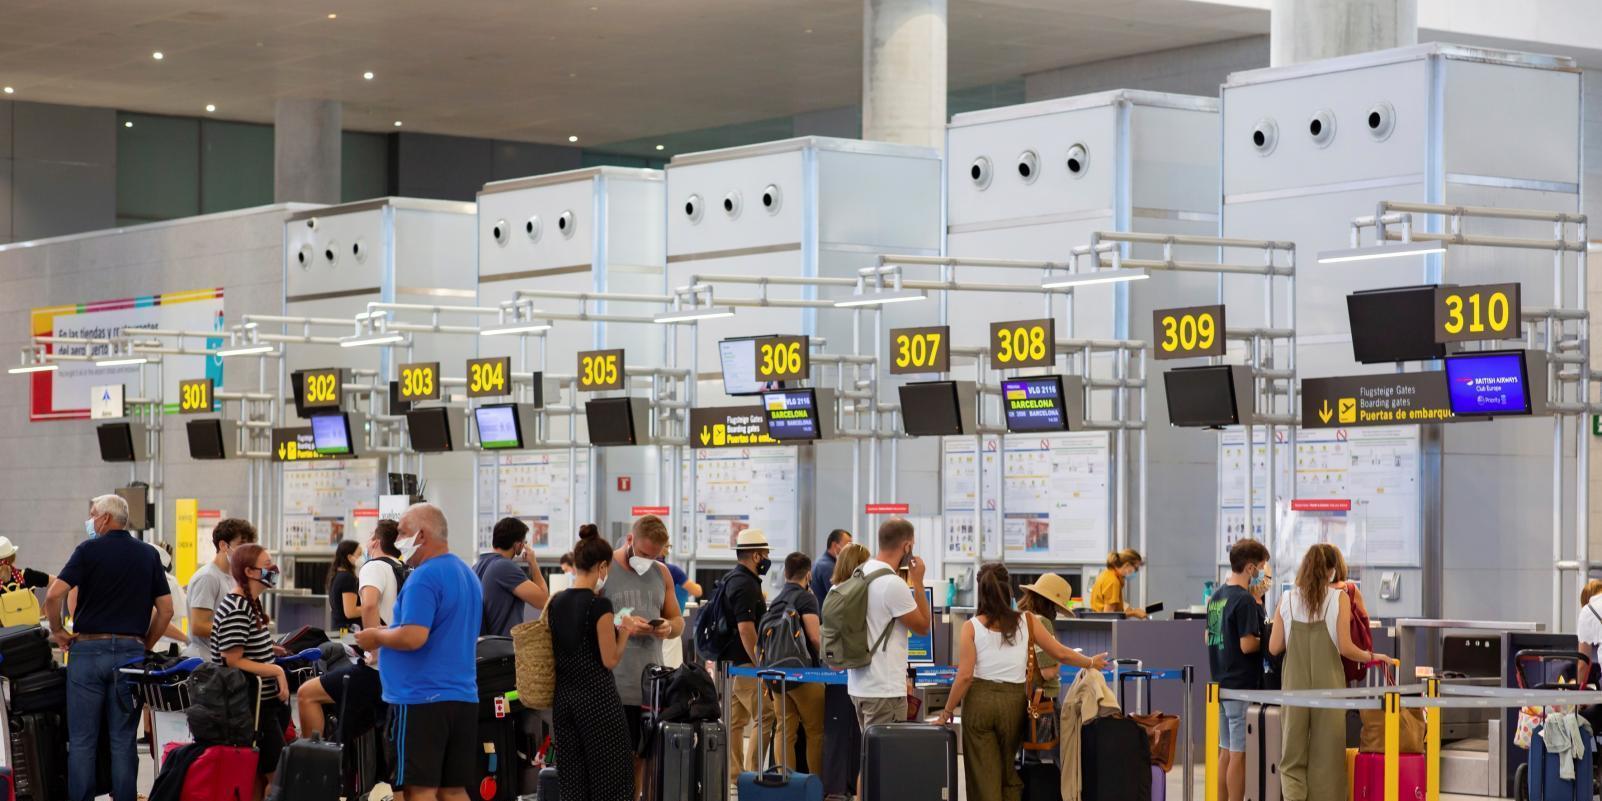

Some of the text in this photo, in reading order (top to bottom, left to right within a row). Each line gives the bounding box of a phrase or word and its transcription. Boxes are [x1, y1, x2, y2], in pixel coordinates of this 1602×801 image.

[1444, 291, 1509, 334] 310
[80, 326, 105, 338] tiendas
[1161, 312, 1214, 352] 309
[895, 333, 941, 367] 307
[997, 325, 1046, 363] 308
[760, 341, 802, 376] 306
[470, 362, 505, 393] 304
[581, 354, 618, 386] 305
[307, 373, 336, 403] 302
[402, 367, 434, 397] 303
[1028, 386, 1041, 394] VLG
[1475, 377, 1496, 385] BRITISH
[182, 383, 208, 410] 301
[1360, 385, 1416, 398] Flugsteige Gates
[1011, 399, 1054, 409] BARCELONA
[1029, 409, 1059, 417] BARCELONA
[1360, 397, 1411, 409] Boarding gates
[771, 410, 808, 419] BARCELONA
[1360, 407, 1452, 421] Puertas de embarqu
[727, 434, 749, 444] Puertas
